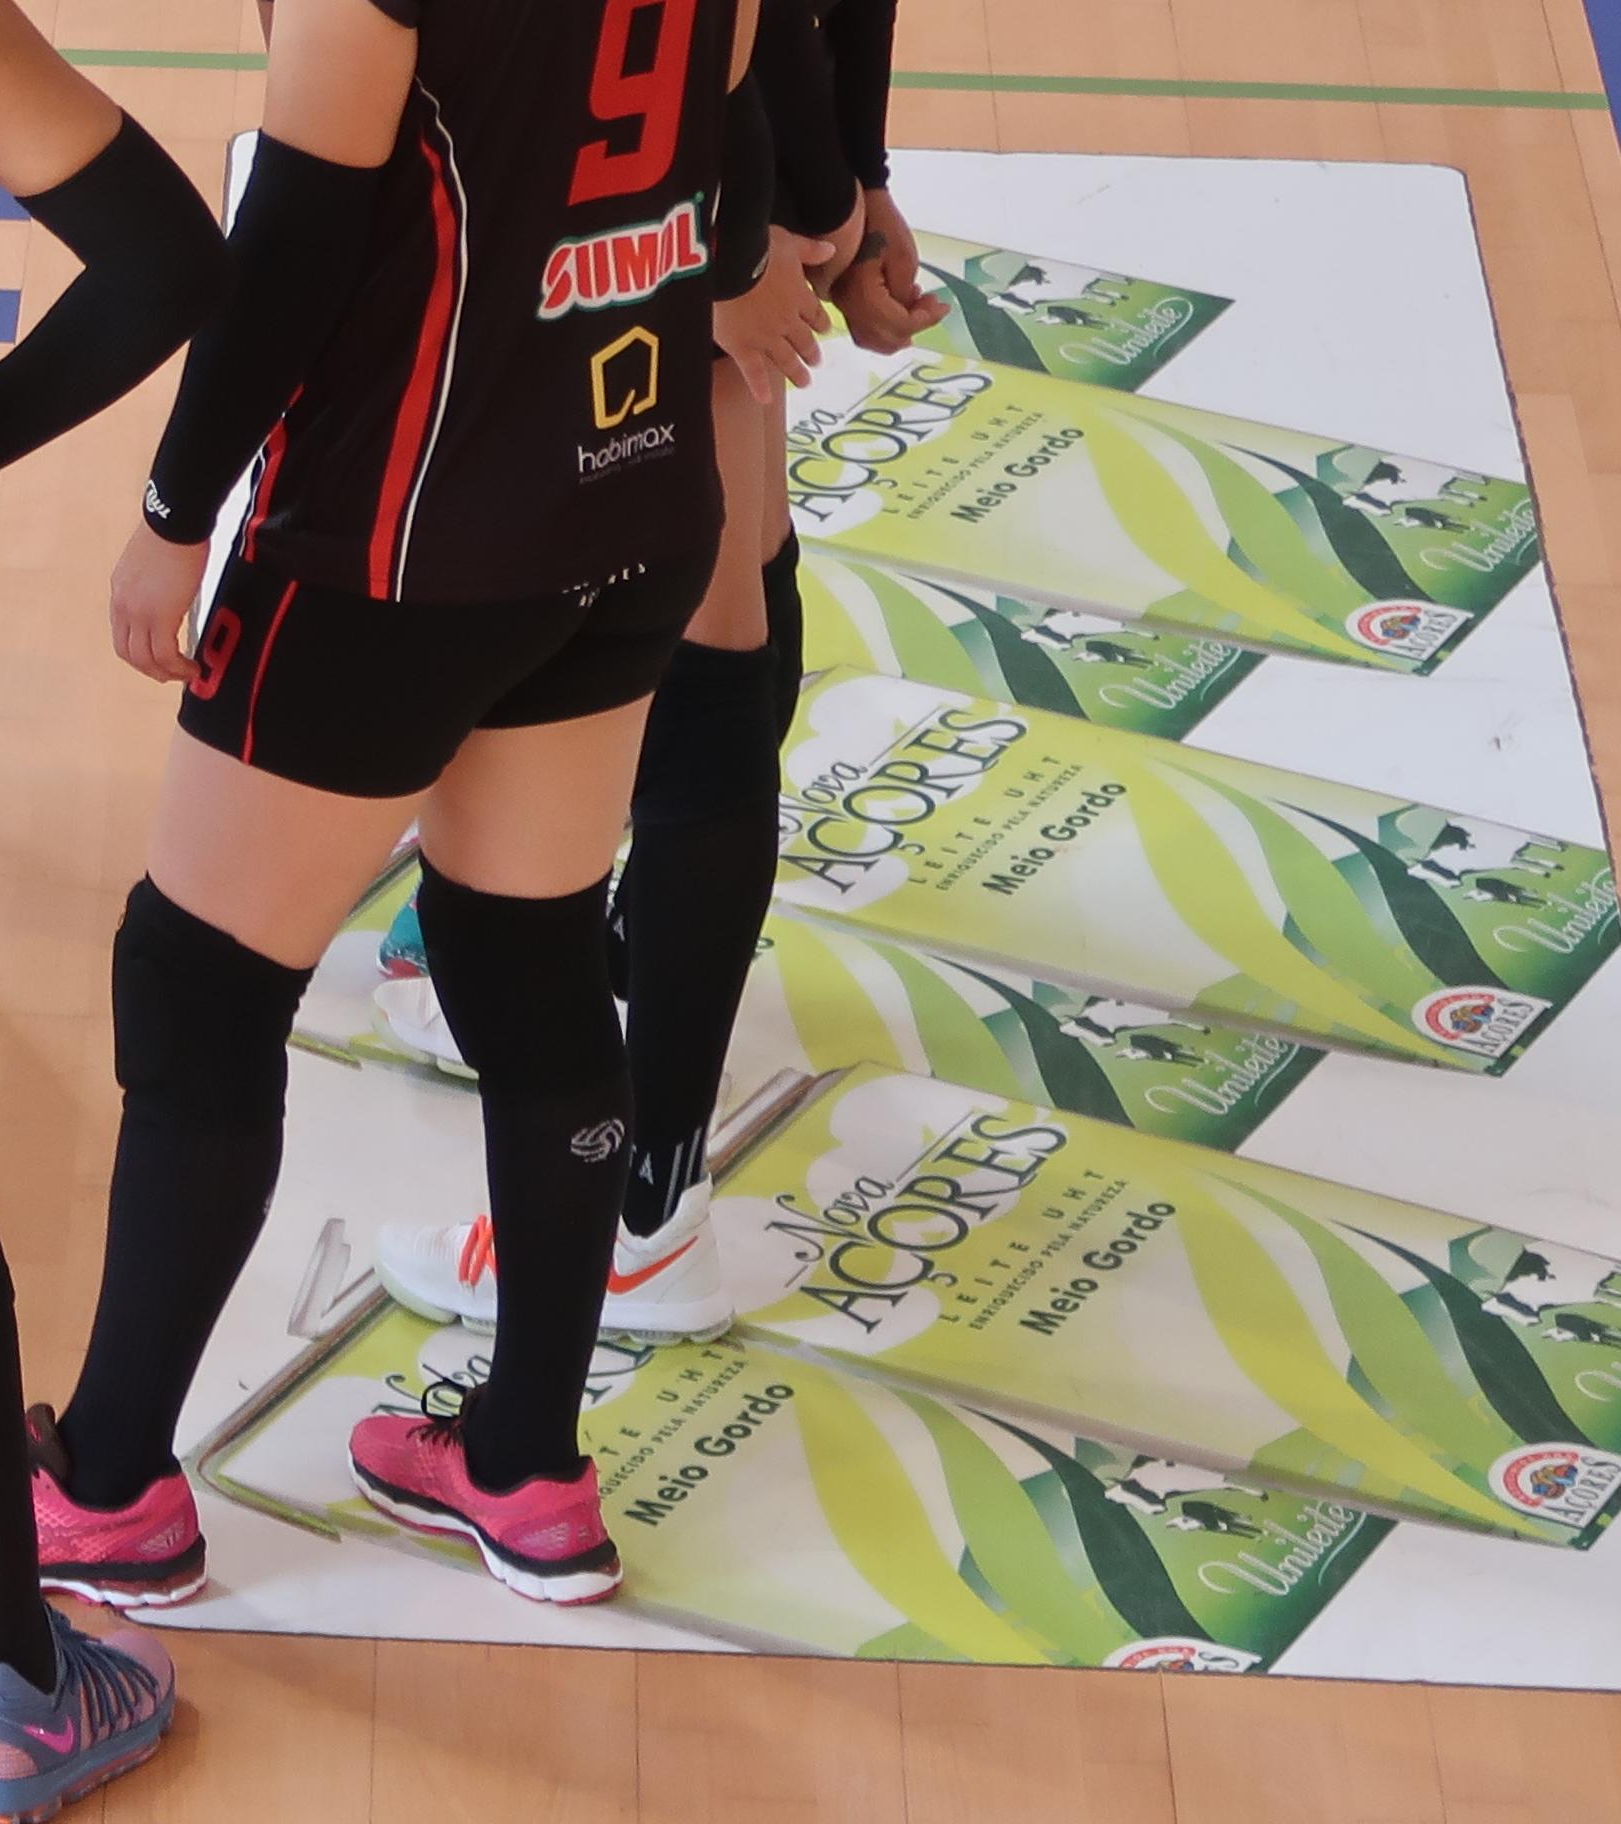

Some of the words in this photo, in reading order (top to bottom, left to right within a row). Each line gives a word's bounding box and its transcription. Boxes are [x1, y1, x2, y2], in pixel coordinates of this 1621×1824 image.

[536, 202, 709, 321] SUMOL
[577, 423, 676, 474] habimax
[788, 364, 994, 524] AÇORES
[950, 480, 1019, 524] Meio
[1003, 427, 1086, 479] Gordo
[970, 403, 1024, 443] UHT
[189, 607, 243, 701] 9
[780, 709, 1028, 895] AÇORES
[909, 816, 992, 886] LEITE
[1004, 755, 1062, 800] UHT
[981, 846, 1056, 897] Meio
[1040, 782, 1128, 843] Gordo
[1029, 762, 1086, 811] NATUREZA
[765, 1175, 897, 1264] Nova
[800, 1113, 1069, 1335] AÇORES
[938, 1241, 1032, 1324] LEITE
[1042, 1168, 1106, 1221] UHT
[968, 1259, 1045, 1332] ENRIQUECIDO
[1042, 1230, 1073, 1261] PELA
[1068, 1179, 1130, 1233] NATUREZA
[1019, 1277, 1100, 1337] Meio
[1082, 1200, 1177, 1273] Gordo
[650, 1416, 686, 1445] PELA
[681, 1359, 748, 1415] NATUREZA
[656, 1349, 723, 1404] UHT
[623, 1464, 710, 1527] Meio
[693, 1383, 796, 1458] Gordo
[1542, 1455, 1621, 1523] AÇORES
[1197, 1501, 1355, 1596] Unileite
